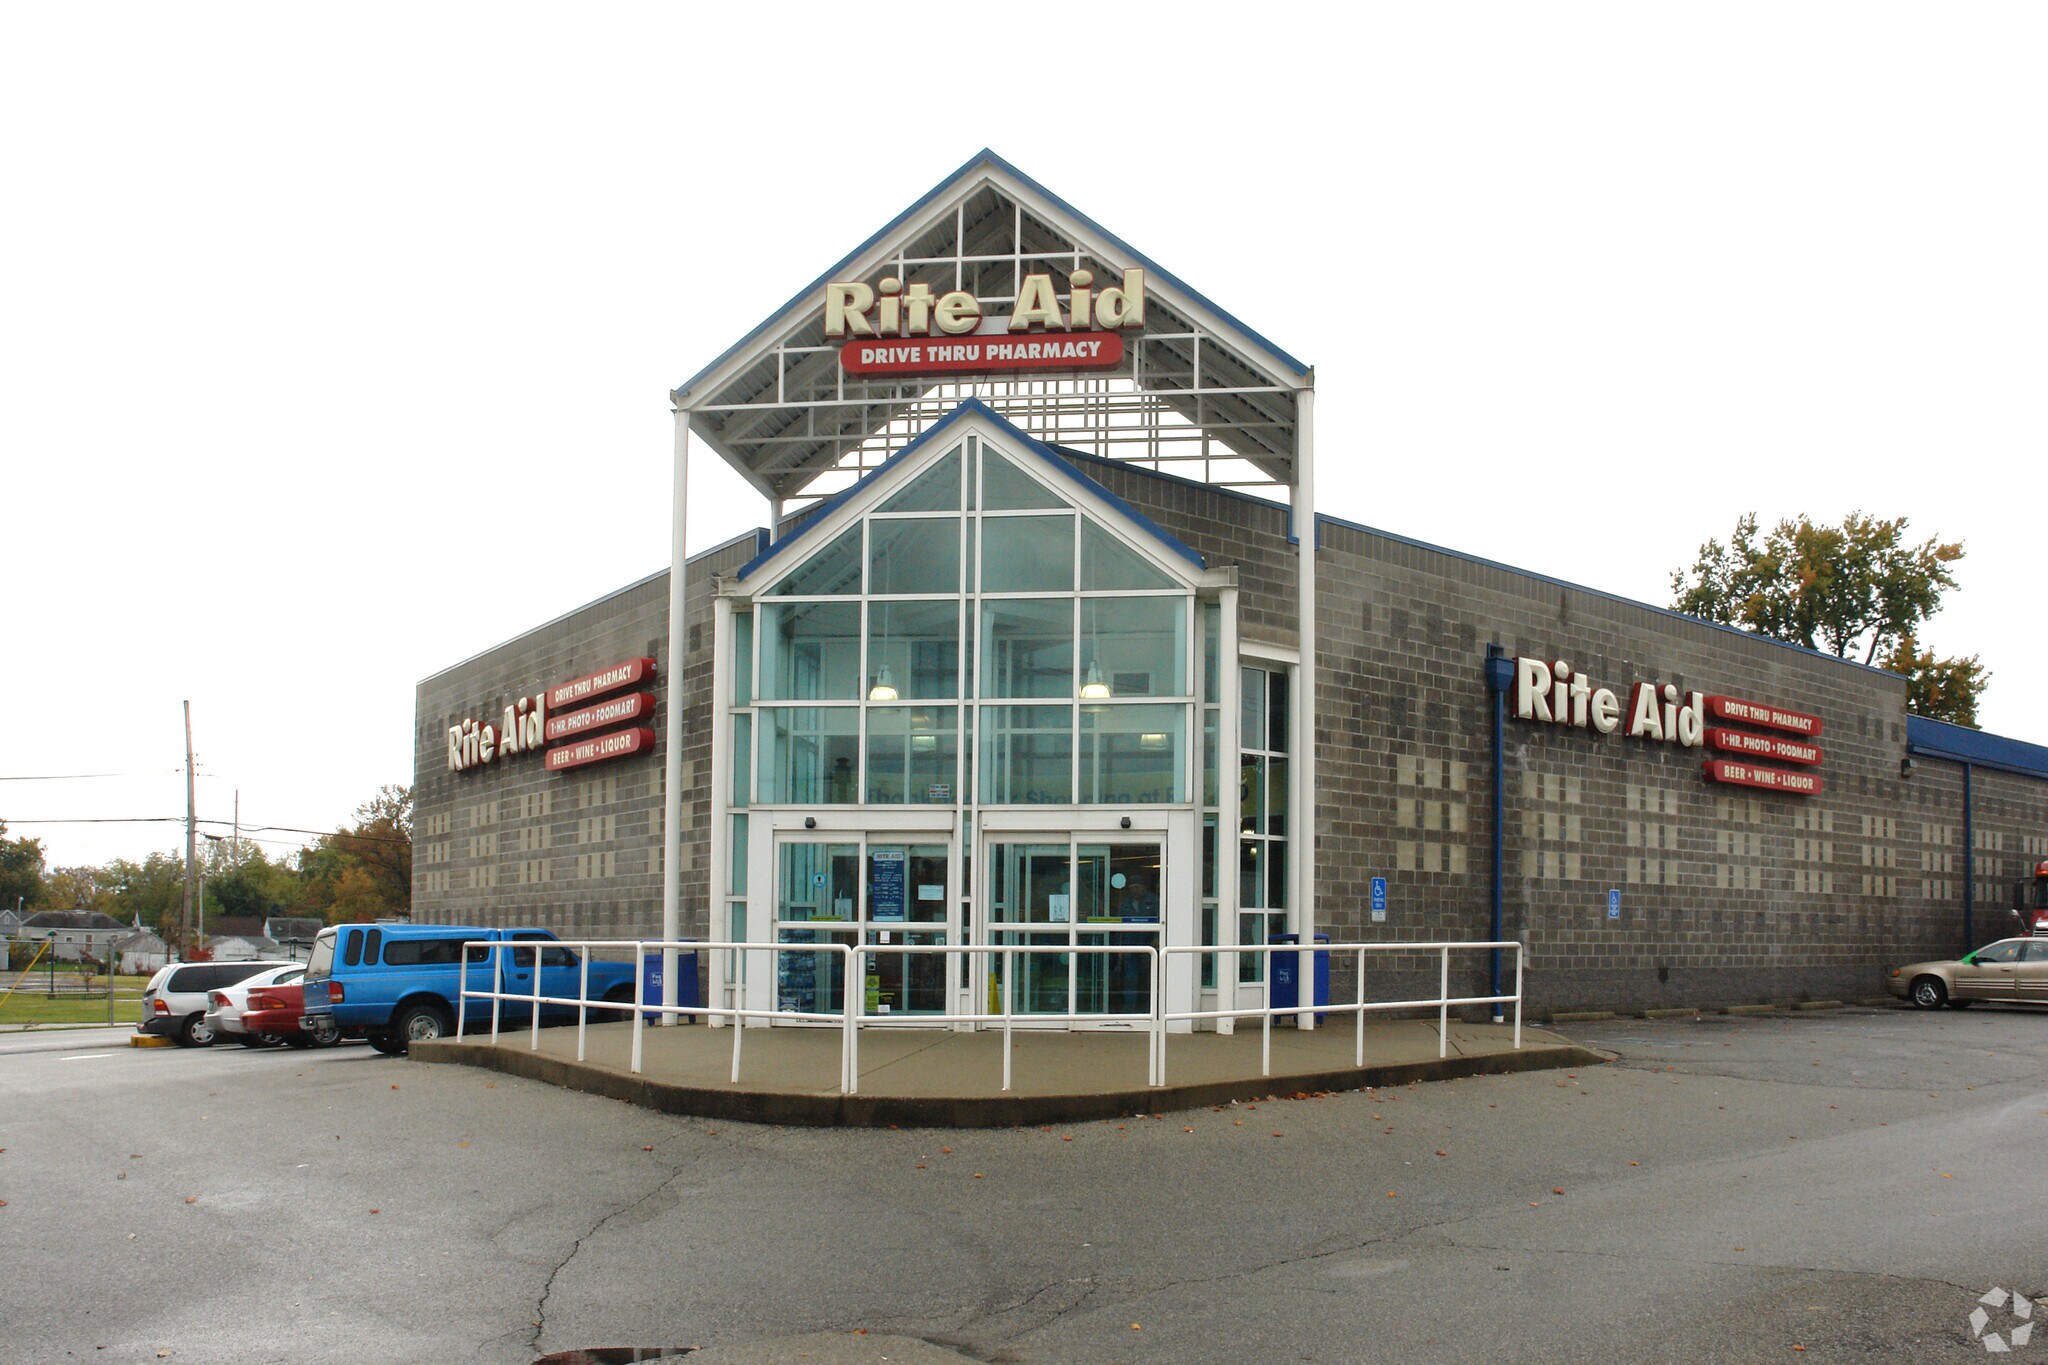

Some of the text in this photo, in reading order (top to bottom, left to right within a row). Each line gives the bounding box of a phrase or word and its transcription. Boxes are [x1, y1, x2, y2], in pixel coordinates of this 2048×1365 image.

[825, 268, 1145, 339] Rite Aid
[861, 340, 1102, 365] DRIVE THRU PHARMACY
[555, 664, 632, 702] DRIVE THRU PHARMACY
[567, 711, 591, 730] PHOTO
[596, 698, 635, 721] FOODMART
[1514, 656, 1704, 747] Rite Aid
[1725, 701, 1813, 731] DRIVE THRU PHARMACY
[448, 692, 546, 771] Rite Aid
[553, 734, 631, 765] BEER WINE LIQUOR
[1743, 736, 1771, 753] PHOTO
[1777, 742, 1817, 761] FOODMART
[1724, 765, 1814, 790] BEER WINE LIQUOR
